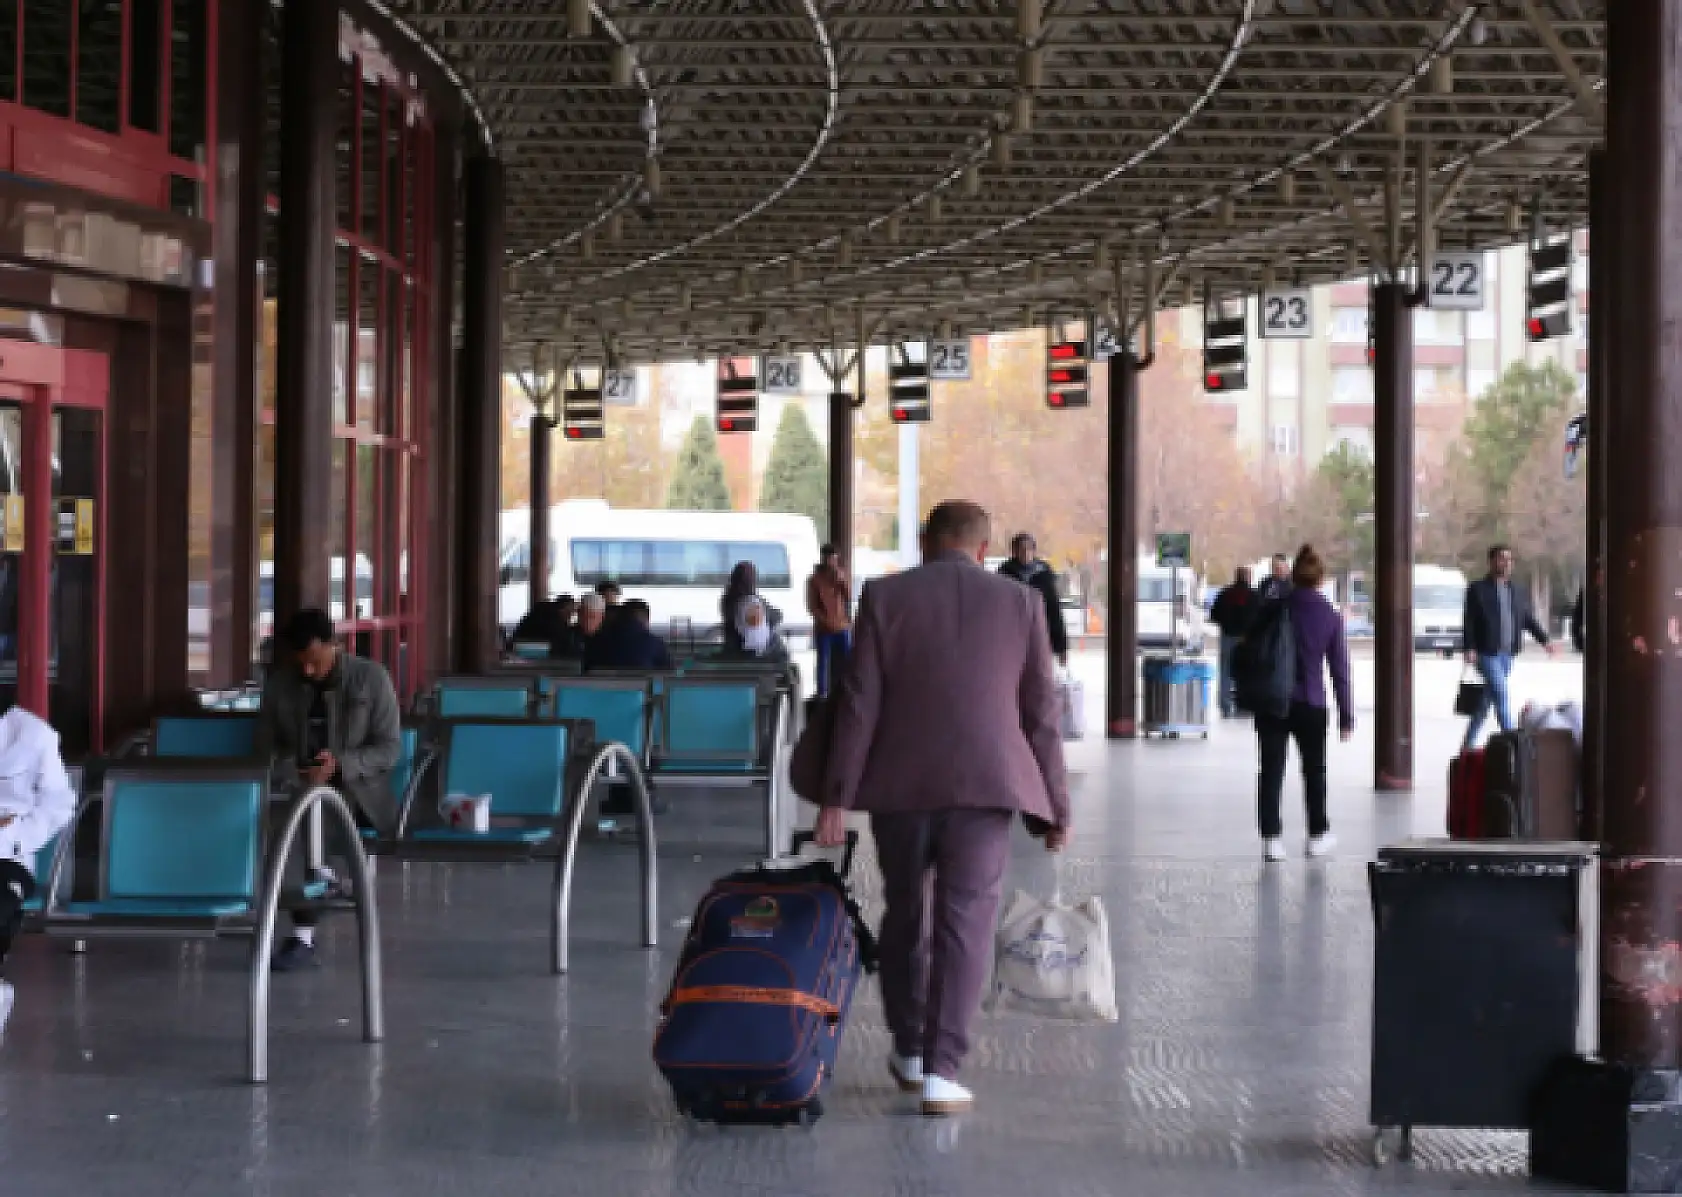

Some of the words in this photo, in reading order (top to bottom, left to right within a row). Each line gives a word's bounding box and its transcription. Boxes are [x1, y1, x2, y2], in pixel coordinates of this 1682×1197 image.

[1432, 260, 1476, 295] 22
[1266, 296, 1307, 329] 23
[932, 344, 967, 371] 25
[606, 375, 632, 397] 27
[768, 362, 797, 387] 26
